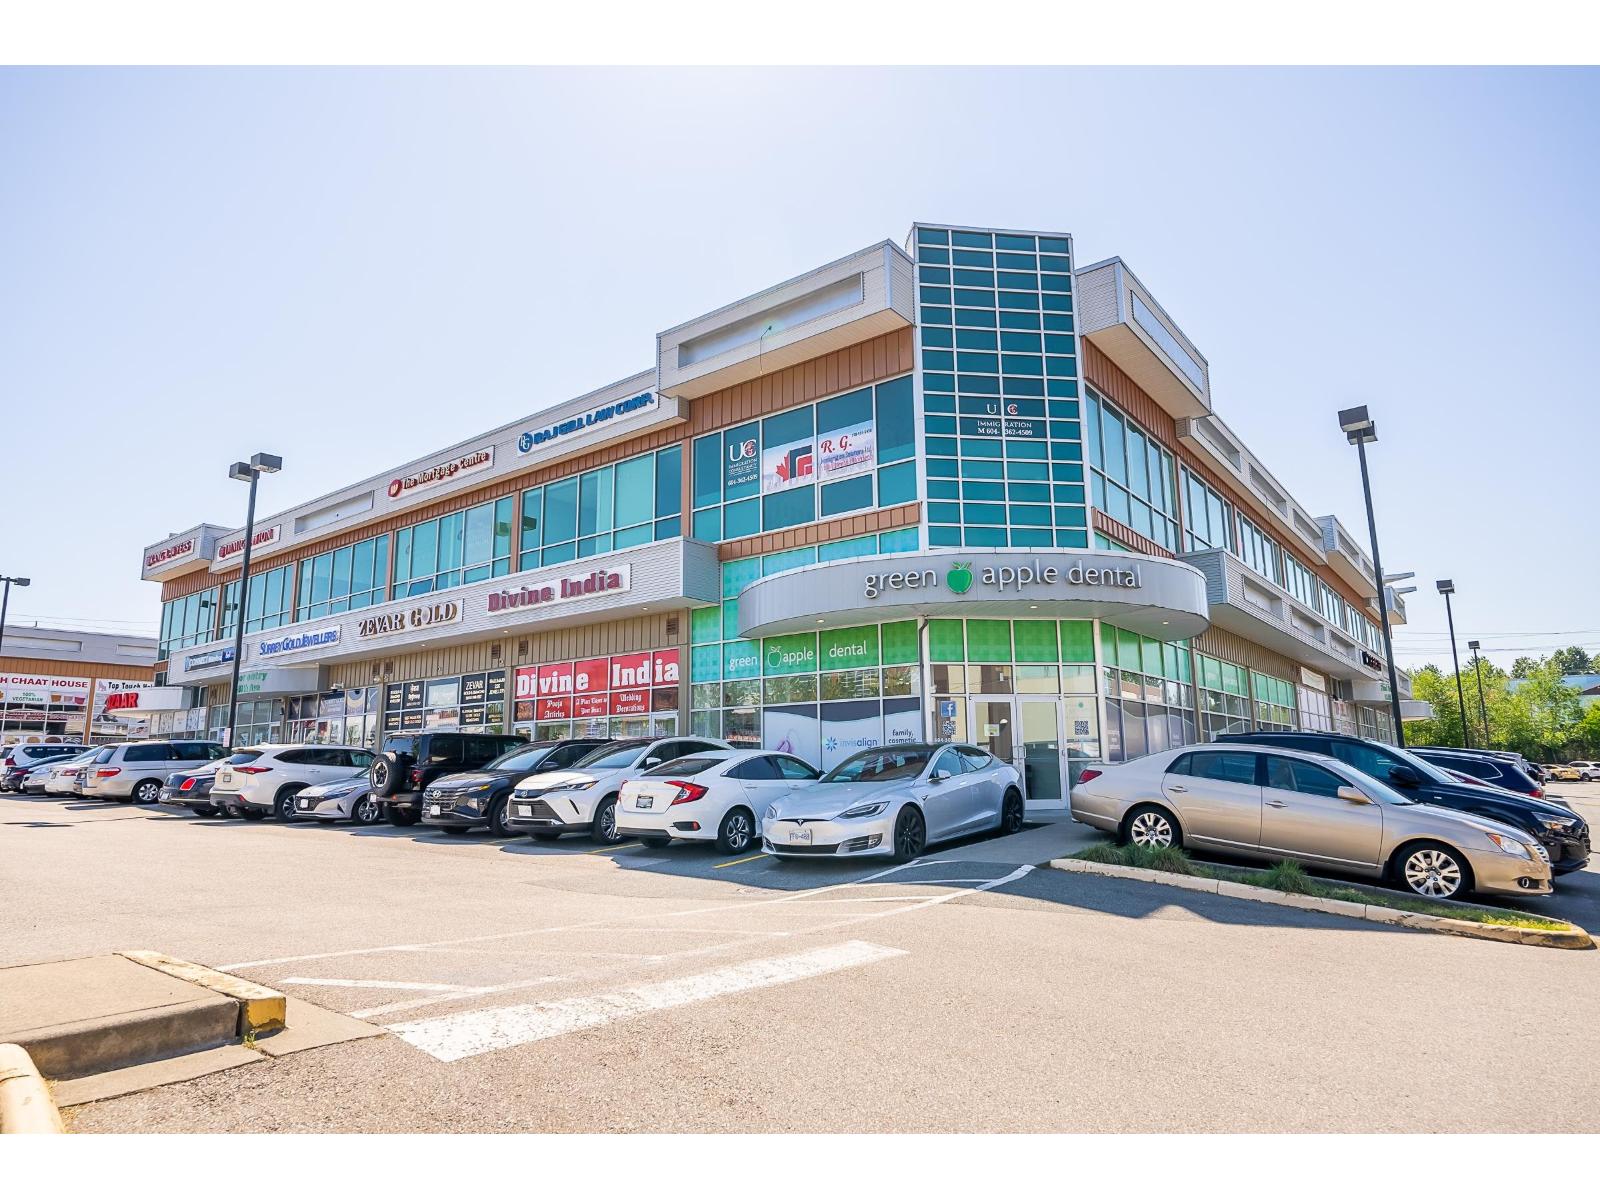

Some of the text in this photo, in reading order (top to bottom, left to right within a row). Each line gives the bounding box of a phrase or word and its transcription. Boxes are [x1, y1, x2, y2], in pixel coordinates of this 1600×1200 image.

[586, 406, 615, 427] LAW
[615, 392, 654, 416] CORP.
[977, 420, 1032, 428] IMMIGRATION
[403, 475, 418, 489] The
[418, 463, 459, 484] Mortgage
[460, 452, 489, 469] Centre
[487, 570, 623, 612] Divine India
[864, 558, 1143, 600] green apple dental
[359, 603, 457, 636] ZEVAR GOLD
[729, 640, 867, 672] green apple dental
[11, 677, 48, 686] CHAAT
[52, 680, 88, 688] HOUSE
[108, 681, 119, 690] Top
[465, 680, 484, 690] ZEVAR
[516, 671, 589, 697] Divine
[611, 658, 679, 688] India
[892, 728, 914, 738] family,
